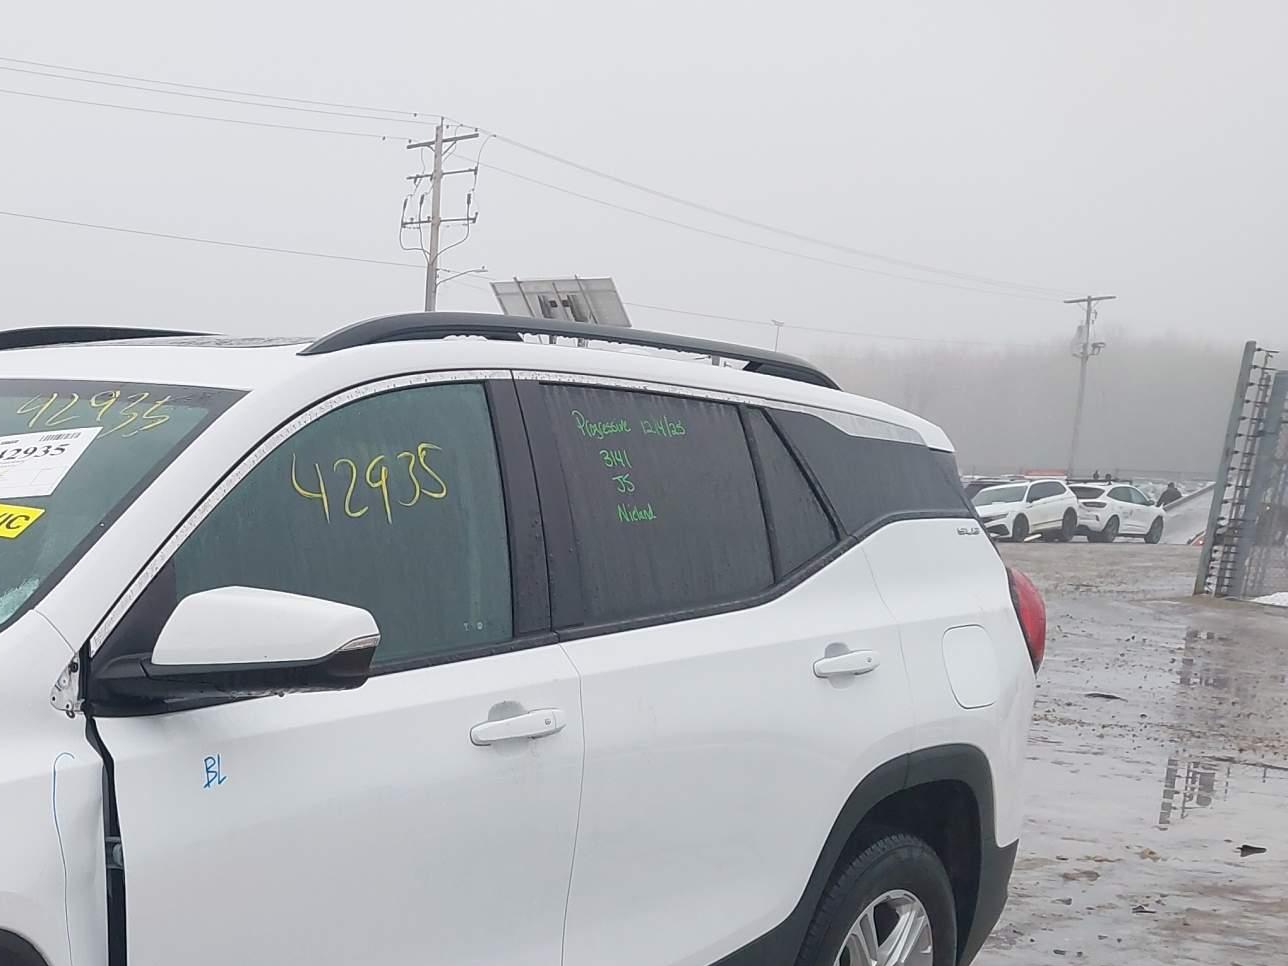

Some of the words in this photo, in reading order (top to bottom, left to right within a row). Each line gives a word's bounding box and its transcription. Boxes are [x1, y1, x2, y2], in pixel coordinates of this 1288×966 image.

[16, 390, 171, 439] 42935
[291, 442, 447, 524] 42935
[203, 753, 227, 789] BL
